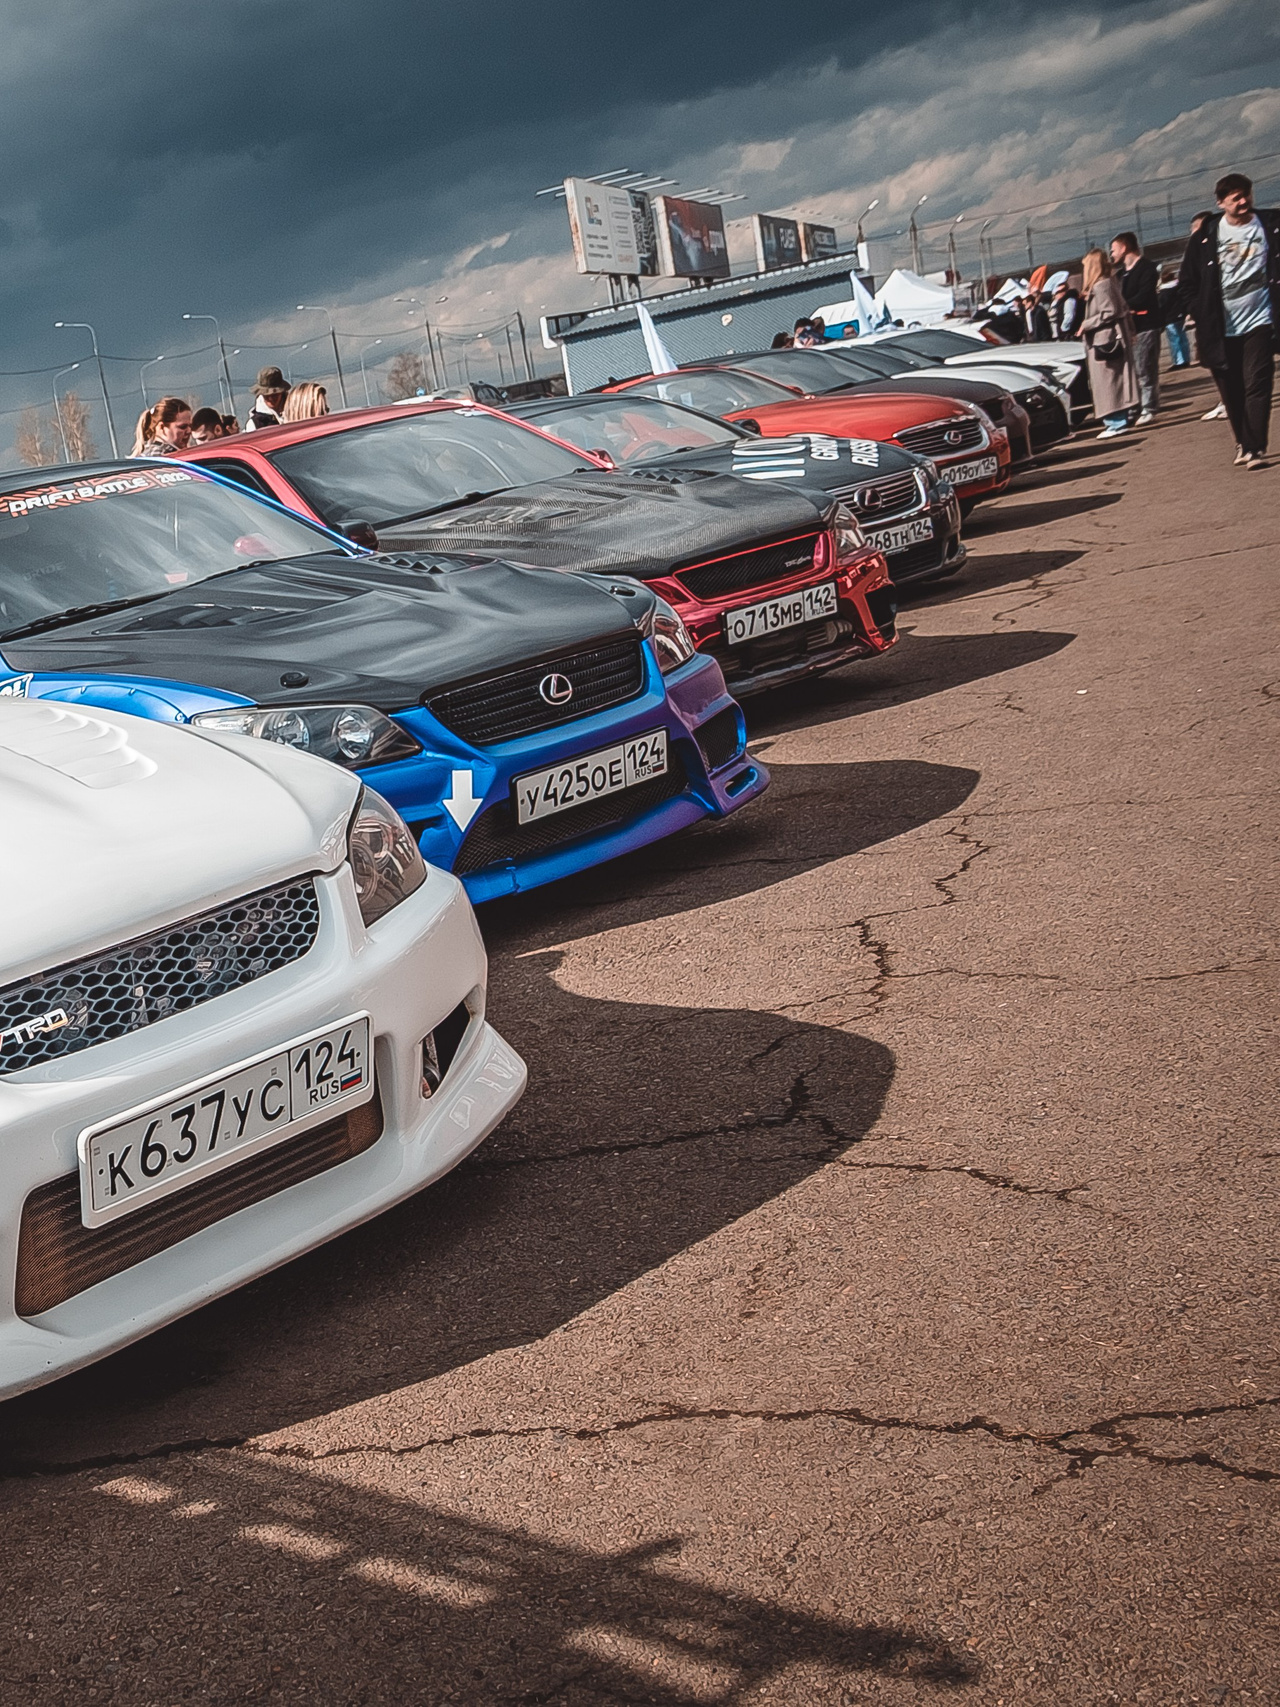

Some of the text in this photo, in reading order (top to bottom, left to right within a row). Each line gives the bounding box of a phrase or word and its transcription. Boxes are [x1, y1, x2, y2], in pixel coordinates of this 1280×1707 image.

[8, 489, 76, 513] DRIFT
[76, 477, 149, 498] BATTLE
[909, 519, 932, 537] 124
[733, 586, 832, 639] О713МВ 142
[810, 606, 825, 616] RUS
[526, 736, 663, 816] У425ОЕ 124
[634, 764, 653, 780] RUS
[3, 1007, 69, 1045] TRD
[308, 1079, 340, 1106] RUS
[107, 1078, 286, 1197] К637УС
[294, 1029, 358, 1090] 124
